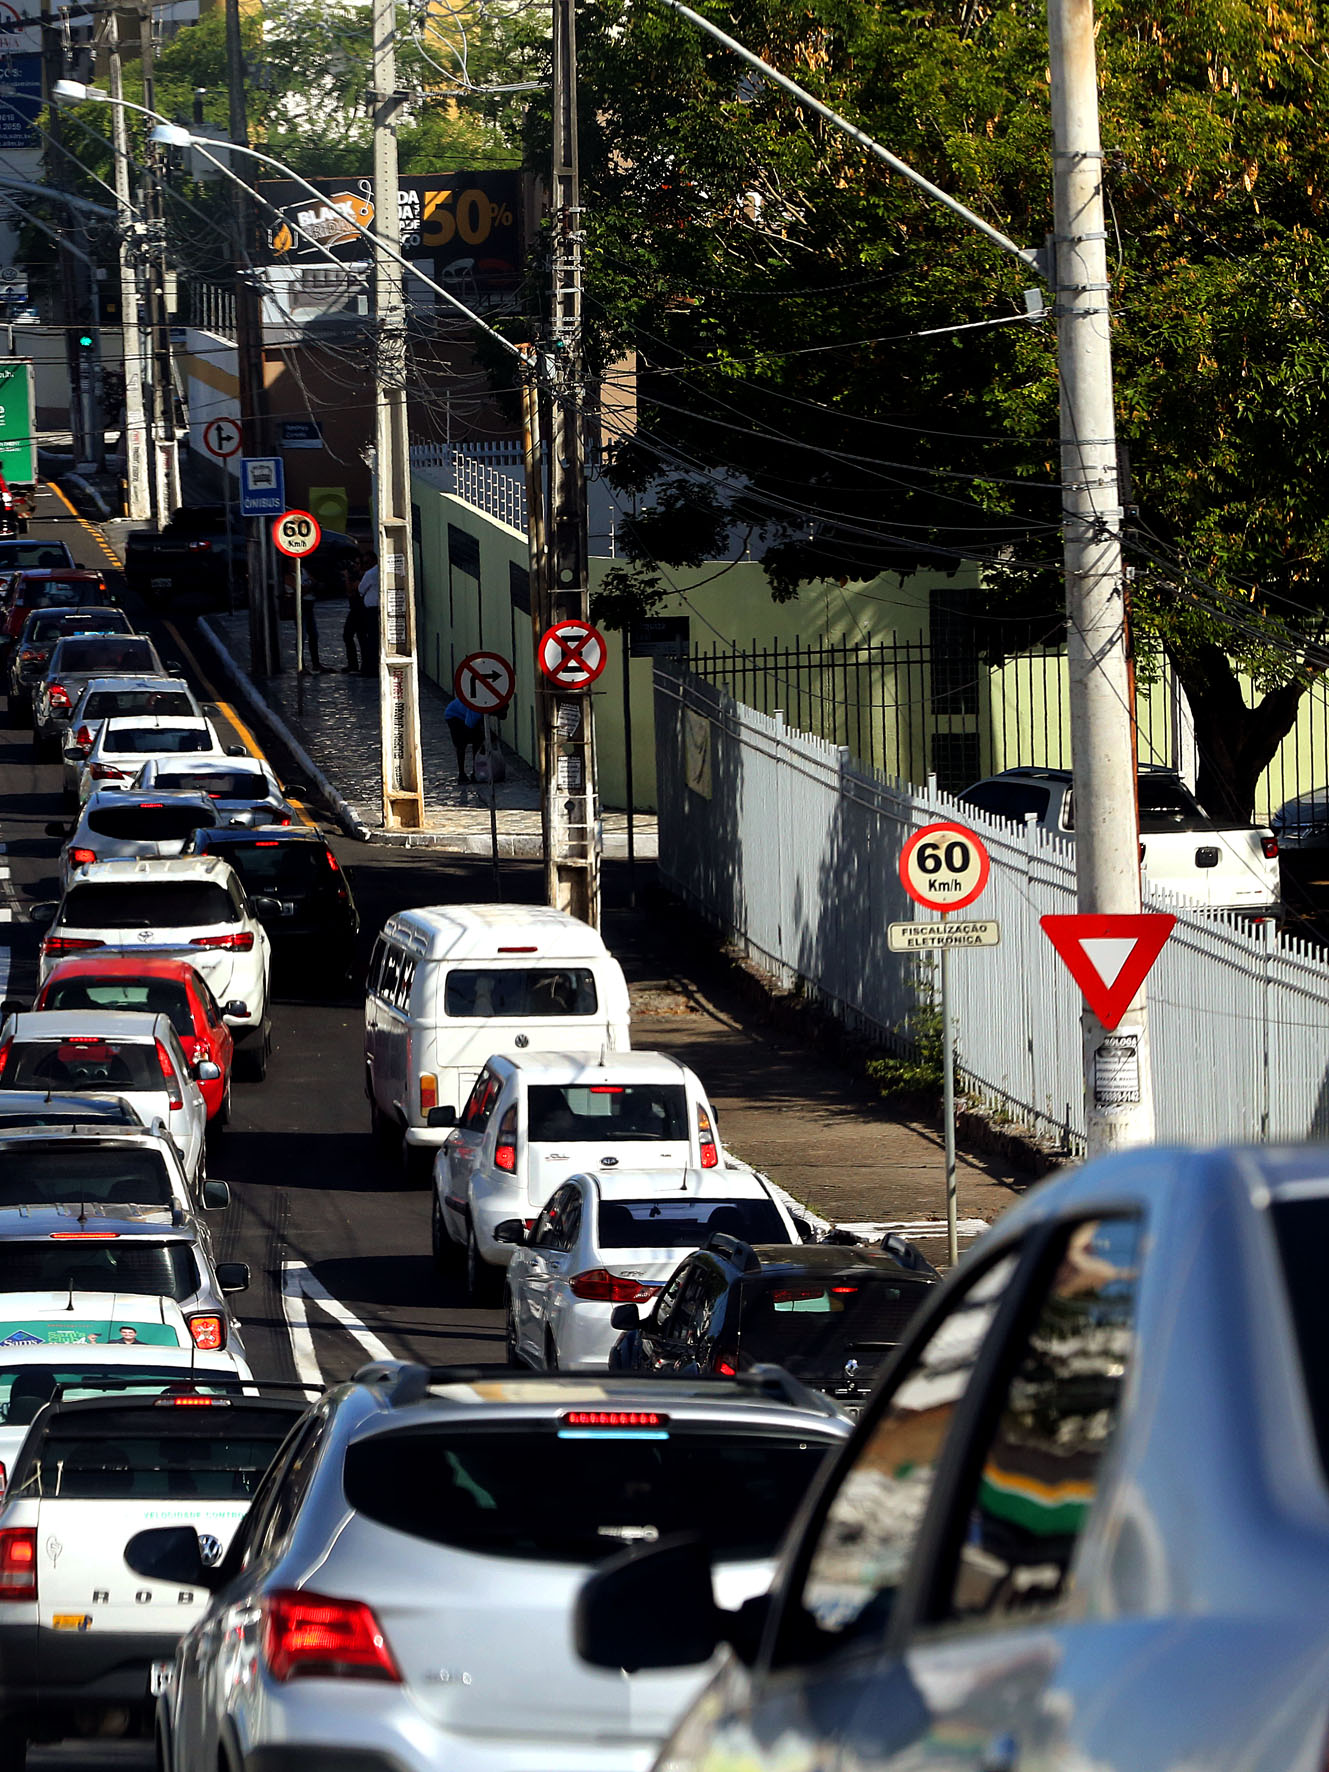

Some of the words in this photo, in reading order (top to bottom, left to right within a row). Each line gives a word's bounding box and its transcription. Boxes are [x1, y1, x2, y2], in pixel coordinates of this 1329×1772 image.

[283, 520, 311, 538] 60
[916, 841, 970, 875] 60
[928, 879, 962, 892] Km/h
[901, 924, 987, 937] FISCALIZAÇÃO
[907, 936, 983, 948] ELETRÔNICA
